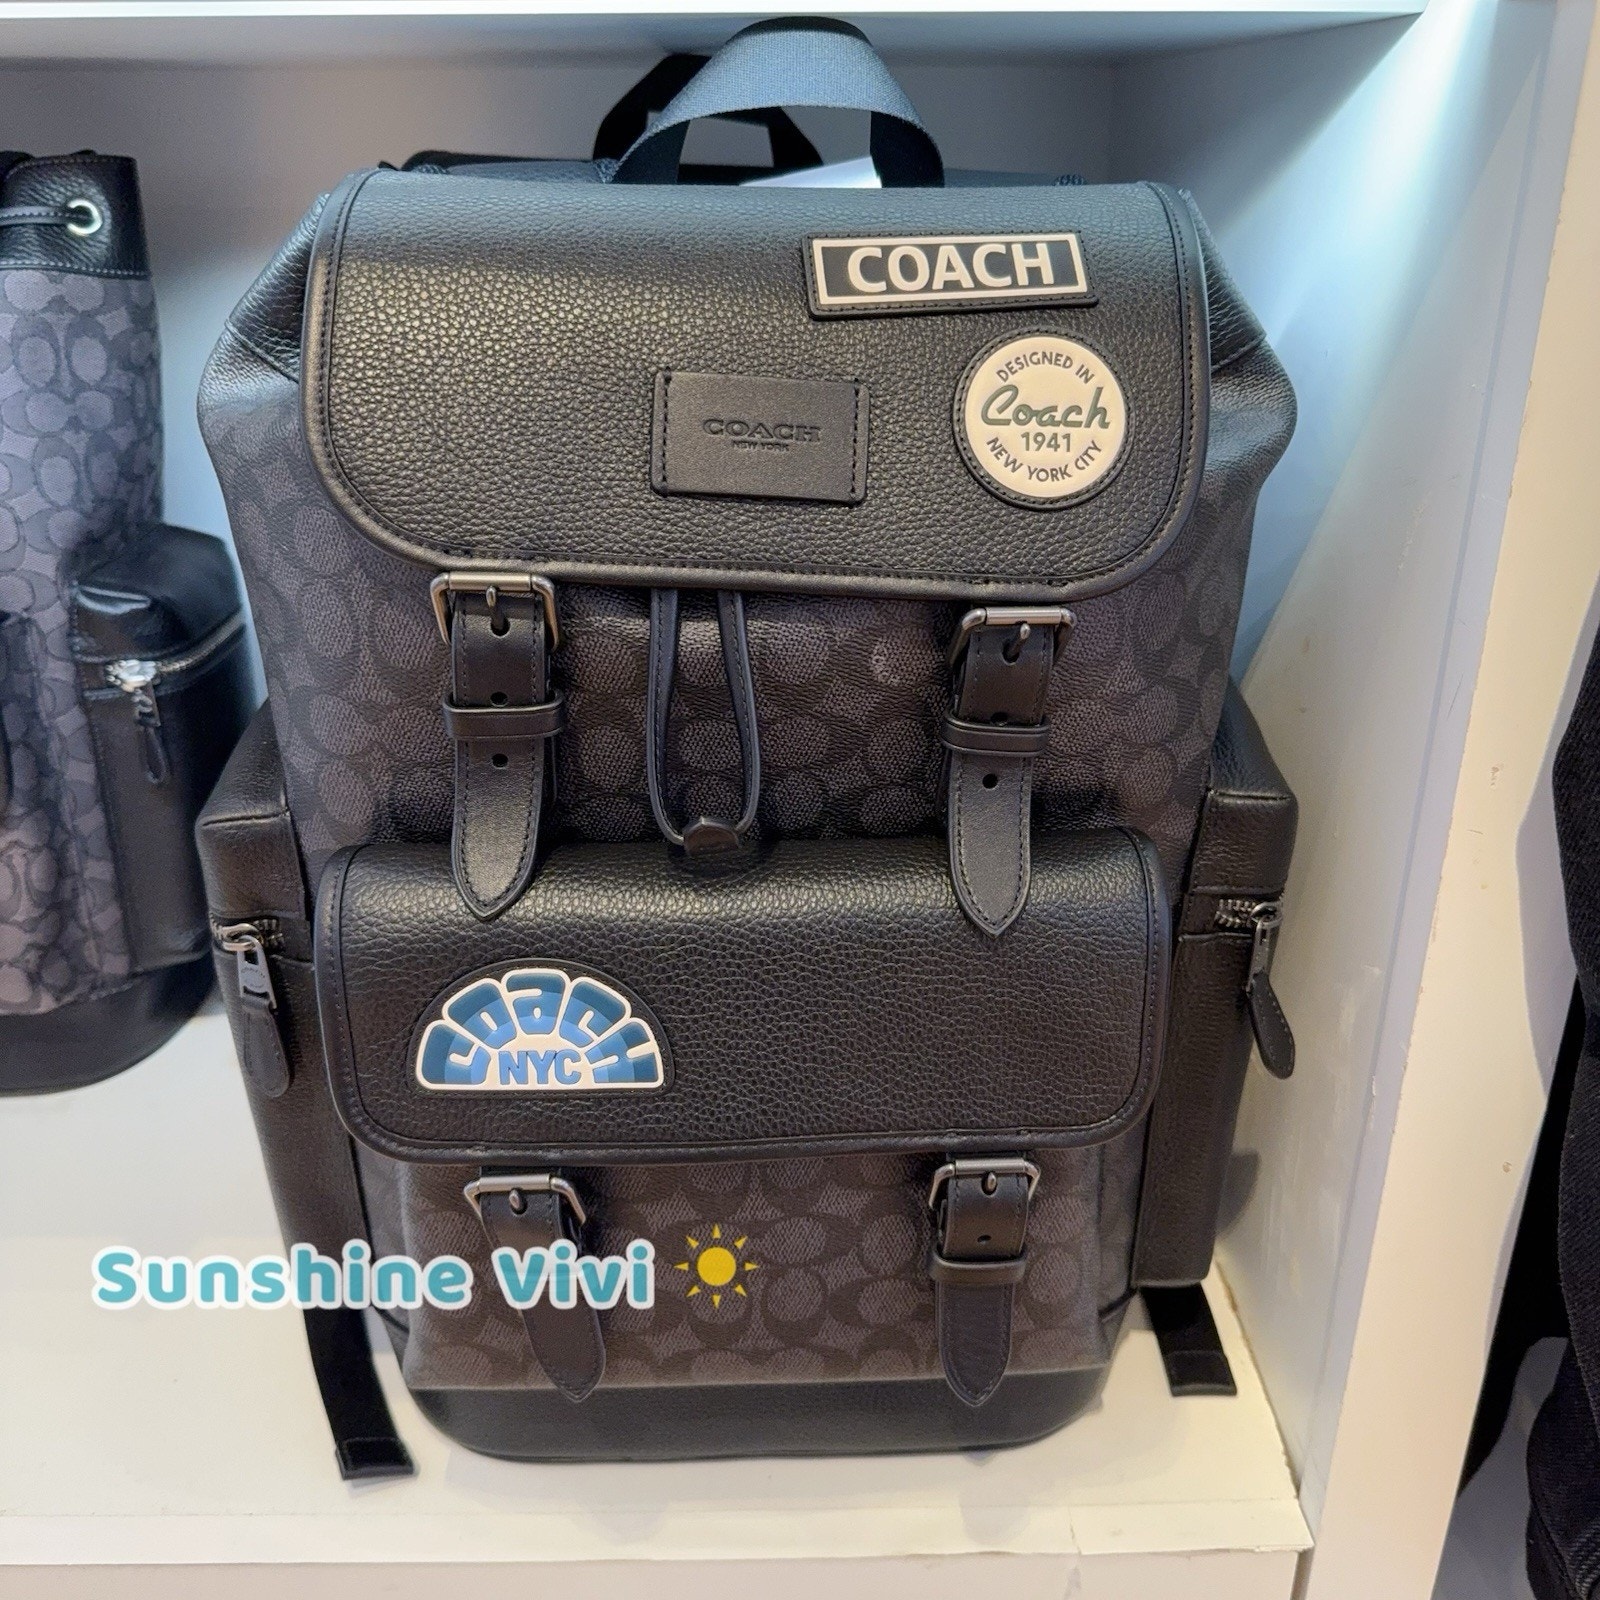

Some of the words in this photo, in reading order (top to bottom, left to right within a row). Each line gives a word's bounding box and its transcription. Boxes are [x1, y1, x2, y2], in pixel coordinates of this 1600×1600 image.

[847, 243, 1054, 292] COACH
[997, 351, 1073, 382] DESIGNED
[1075, 364, 1095, 384] IN
[981, 384, 1111, 429] Coach
[703, 419, 821, 442] COACH
[732, 439, 757, 450] NEW
[760, 441, 789, 451] YORK
[1021, 432, 1072, 452] 1941
[987, 437, 1024, 474] NEW
[1027, 466, 1072, 482] YORK
[1074, 440, 1103, 471] CITY
[498, 1049, 582, 1085] NYC
